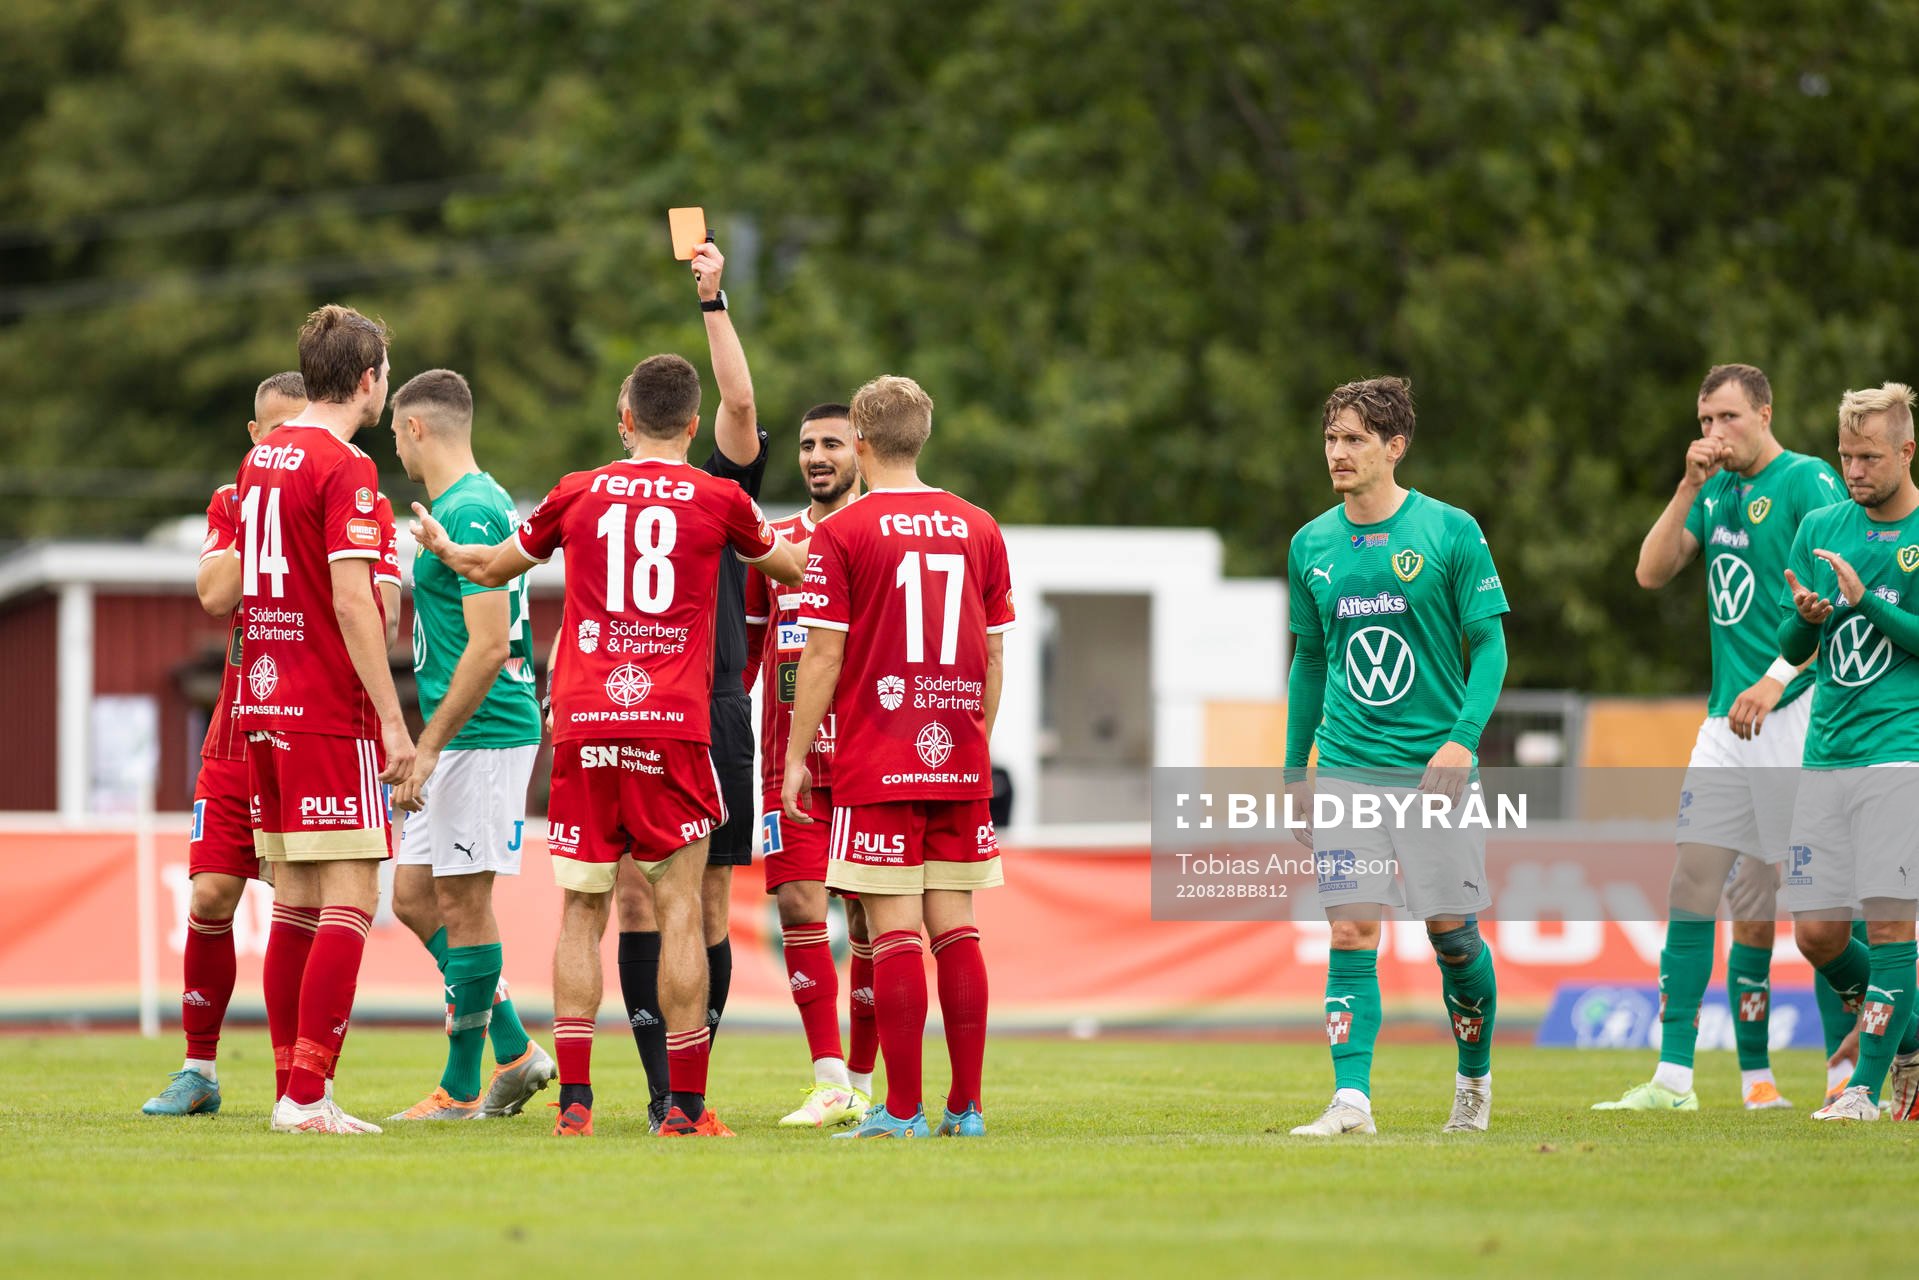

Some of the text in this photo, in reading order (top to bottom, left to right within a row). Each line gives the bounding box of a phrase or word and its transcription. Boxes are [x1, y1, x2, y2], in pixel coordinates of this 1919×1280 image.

[247, 442, 305, 471] renta
[590, 474, 695, 501] renta
[879, 510, 969, 538] renta
[241, 486, 290, 598] 14
[597, 503, 677, 614] 18
[802, 573, 827, 585] erva
[800, 591, 829, 609] oop
[896, 551, 965, 665] 17
[1337, 593, 1407, 618] Atteviks
[248, 607, 304, 627] Söderberg
[247, 625, 304, 641] & Partners
[609, 620, 689, 642] Söderberg
[607, 638, 685, 655] & Partners
[914, 675, 982, 697] Söderberg
[913, 694, 980, 711] & Partners
[571, 710, 684, 722] COMPASSEN.NU
[580, 745, 619, 769] SN
[621, 746, 661, 762] Skövde
[882, 773, 979, 785] COMPASSEN.NU
[298, 796, 358, 816] PULS
[547, 820, 581, 845] ULS
[851, 831, 905, 854] PULS
